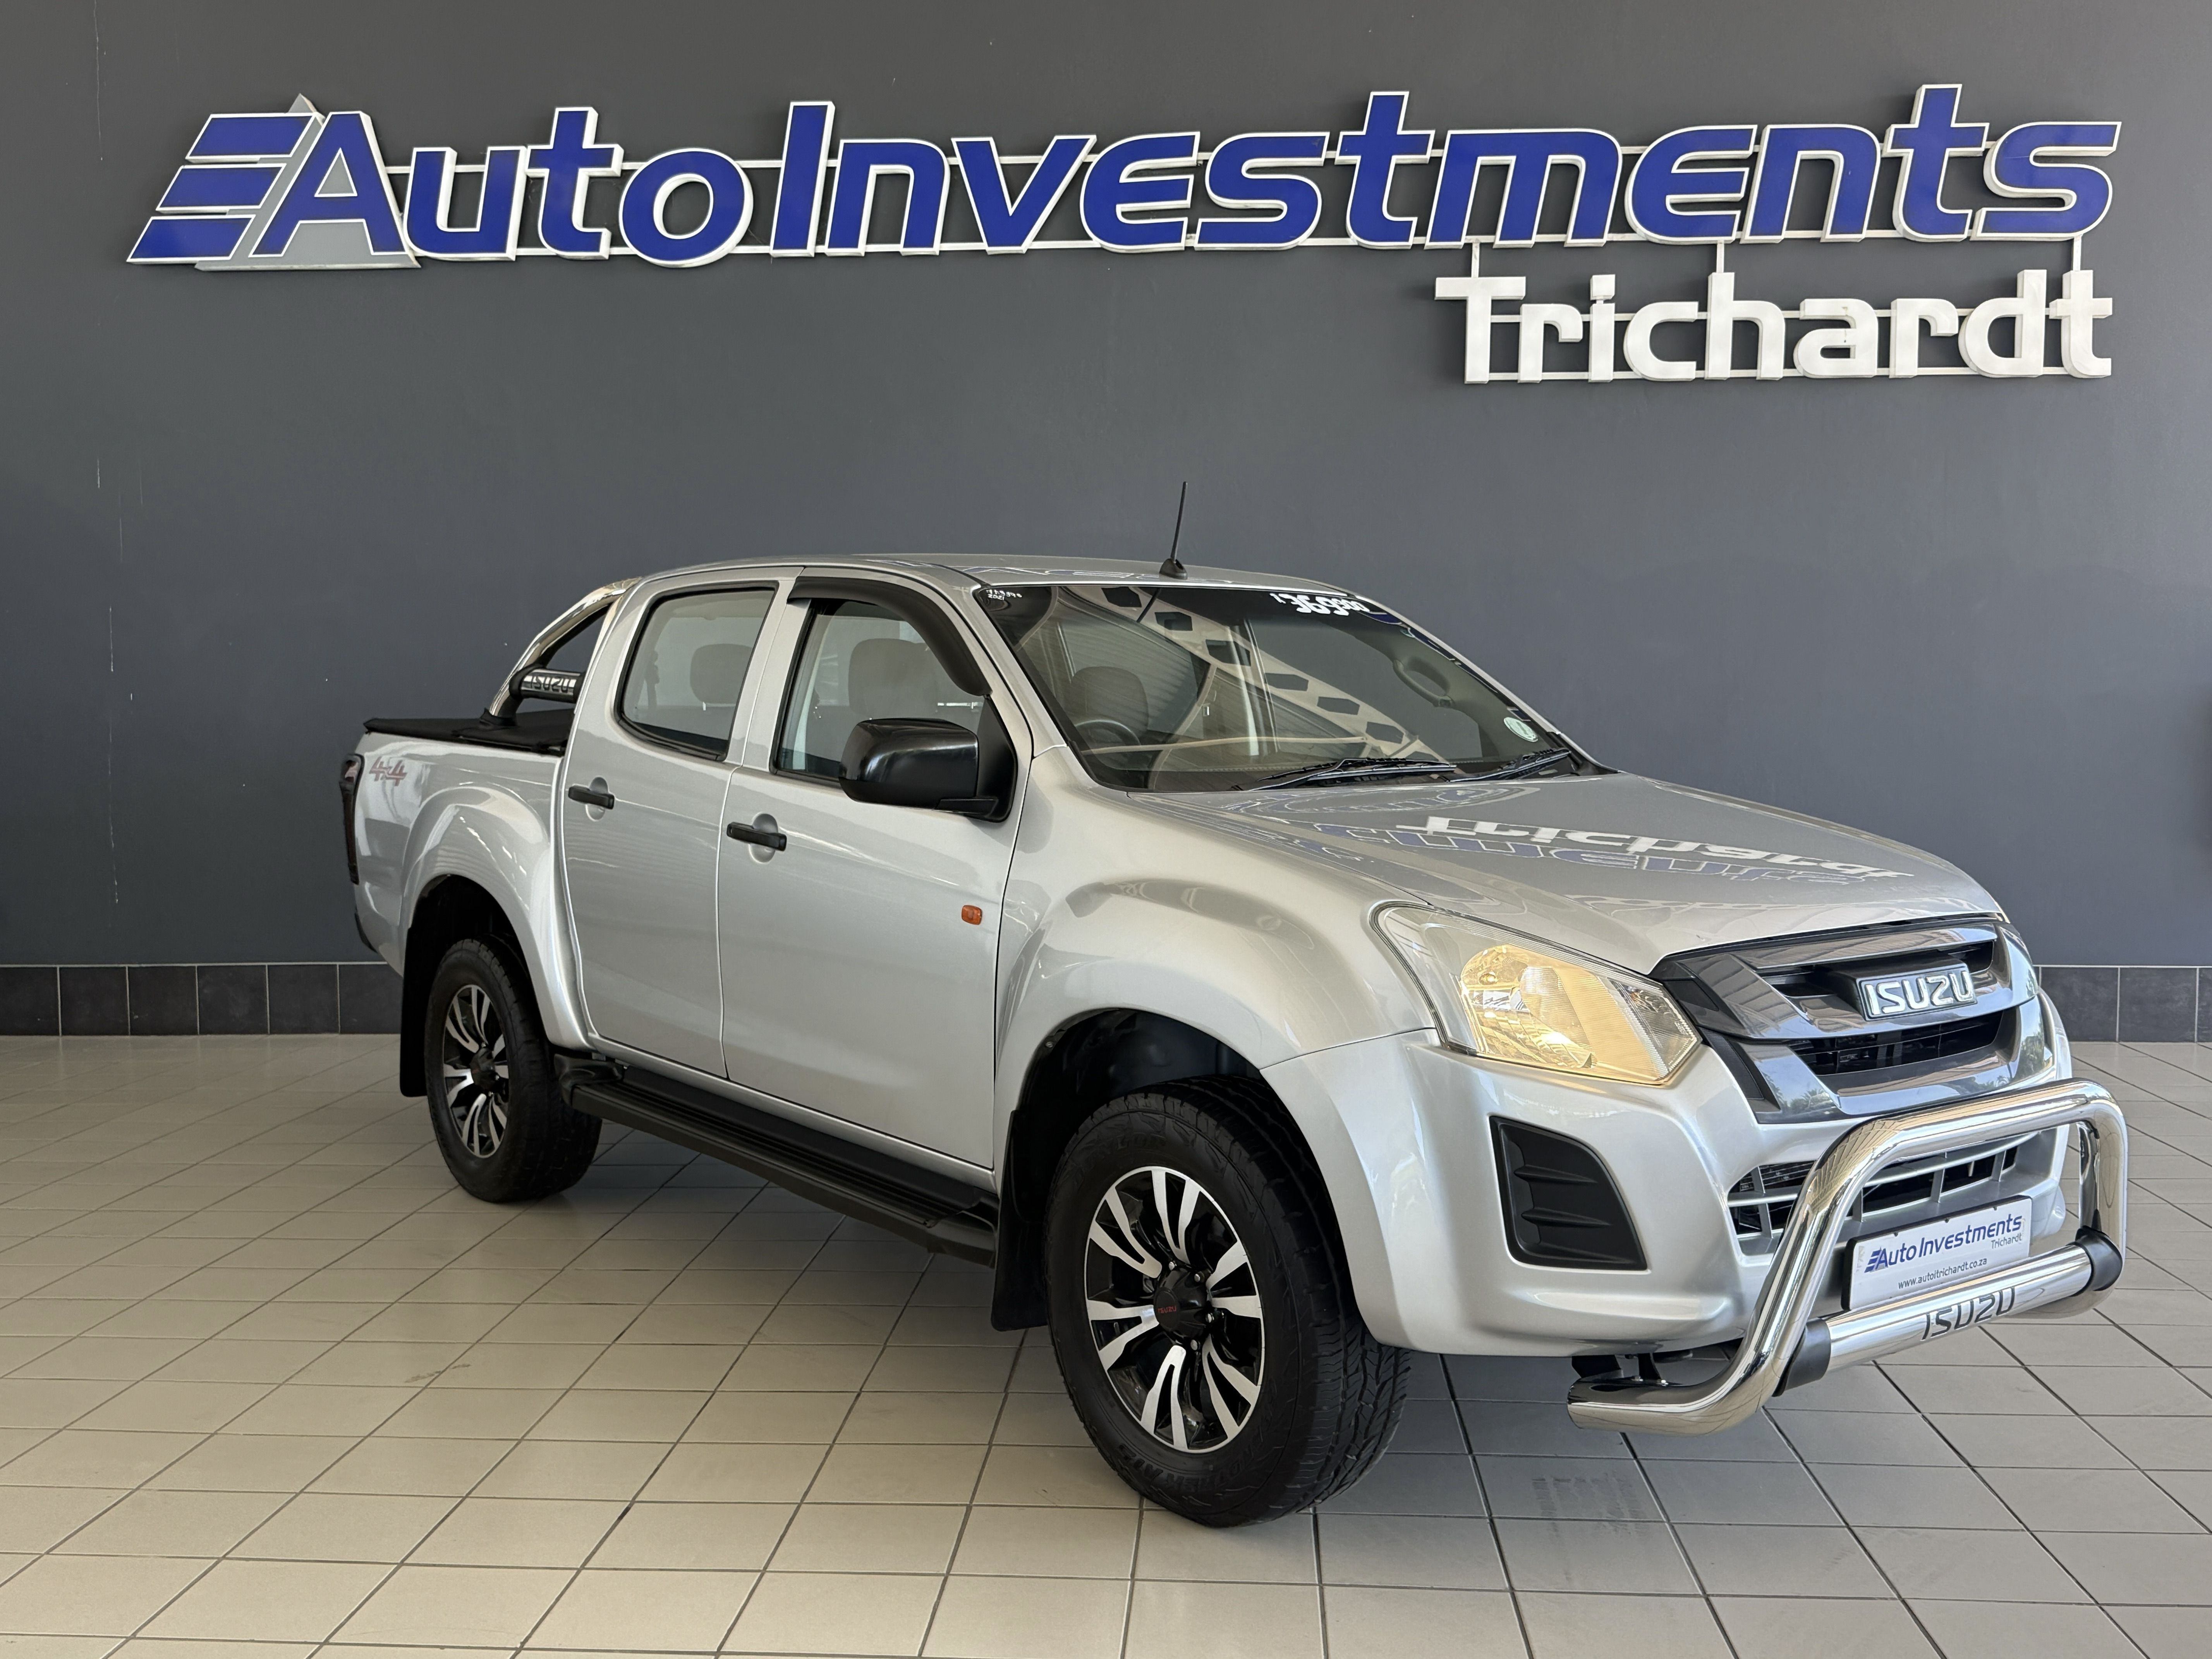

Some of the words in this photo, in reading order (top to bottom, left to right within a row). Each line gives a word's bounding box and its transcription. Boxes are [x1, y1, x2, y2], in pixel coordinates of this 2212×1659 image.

[1435, 269, 2113, 383] Trichardt
[531, 675, 571, 694] ISUZU
[1864, 970, 1974, 1015] ISUZU
[1991, 1233, 2022, 1249] Trichardt
[1898, 1257, 1987, 1289] www.autoitrichardt.co.za
[1158, 1305, 1176, 1314] ISUZU
[1921, 1286, 2015, 1340] ISUZU
